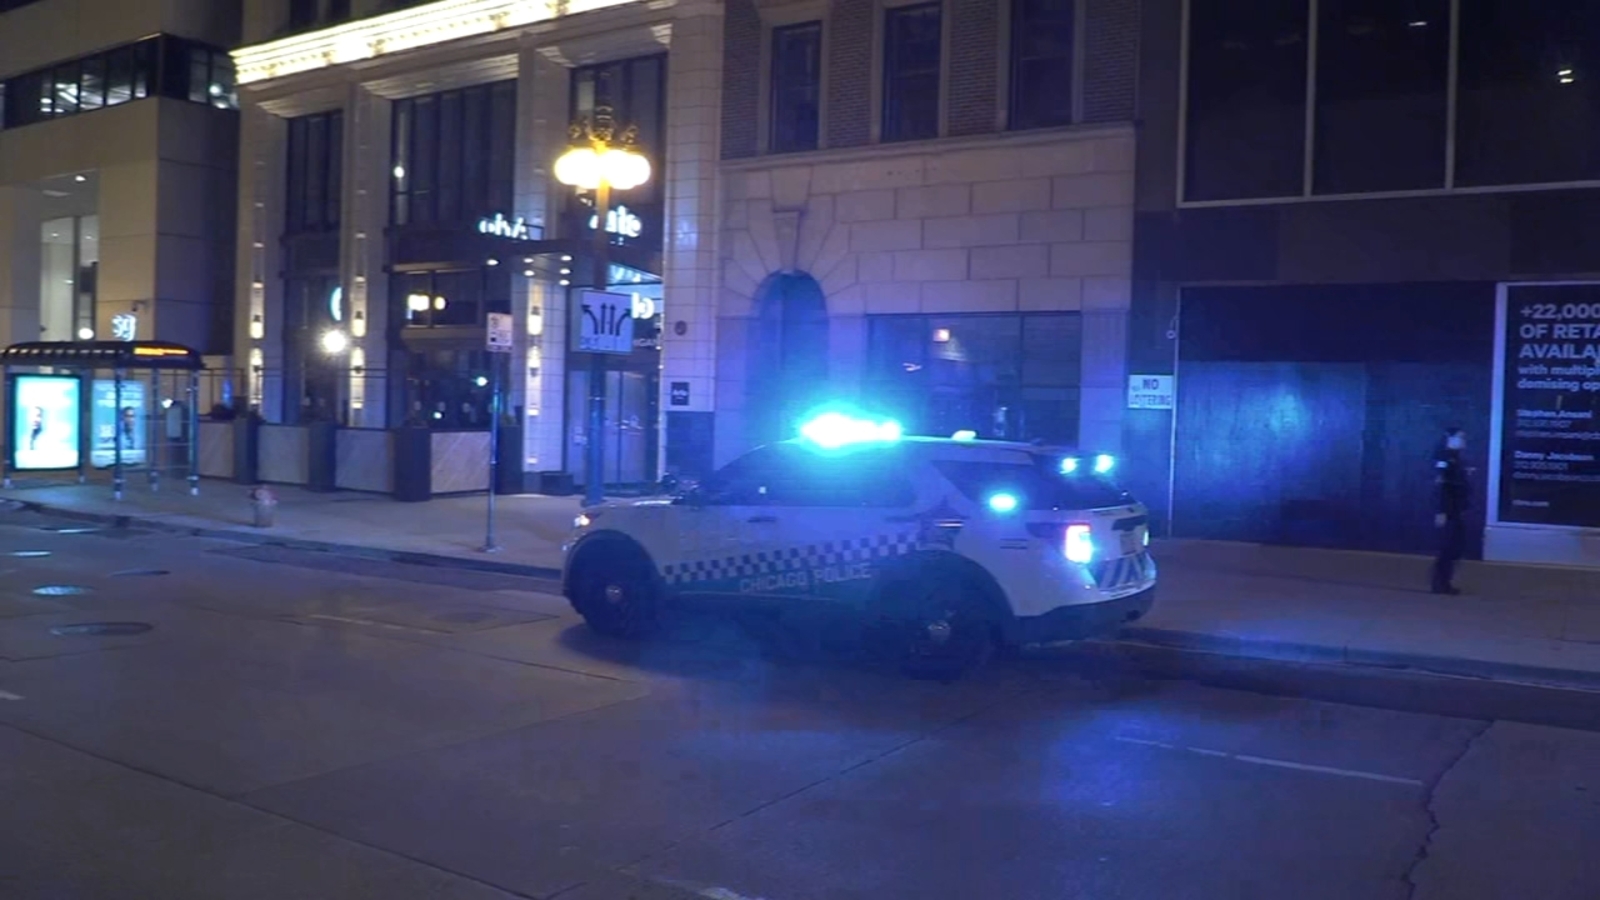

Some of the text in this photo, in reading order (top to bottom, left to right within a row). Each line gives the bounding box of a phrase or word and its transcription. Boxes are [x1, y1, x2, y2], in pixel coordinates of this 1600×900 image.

[1520, 323, 1548, 339] OF
[1519, 343, 1600, 359] AVAILA
[1143, 378, 1159, 390] NO
[739, 561, 872, 593] CHICAGO POLICE
